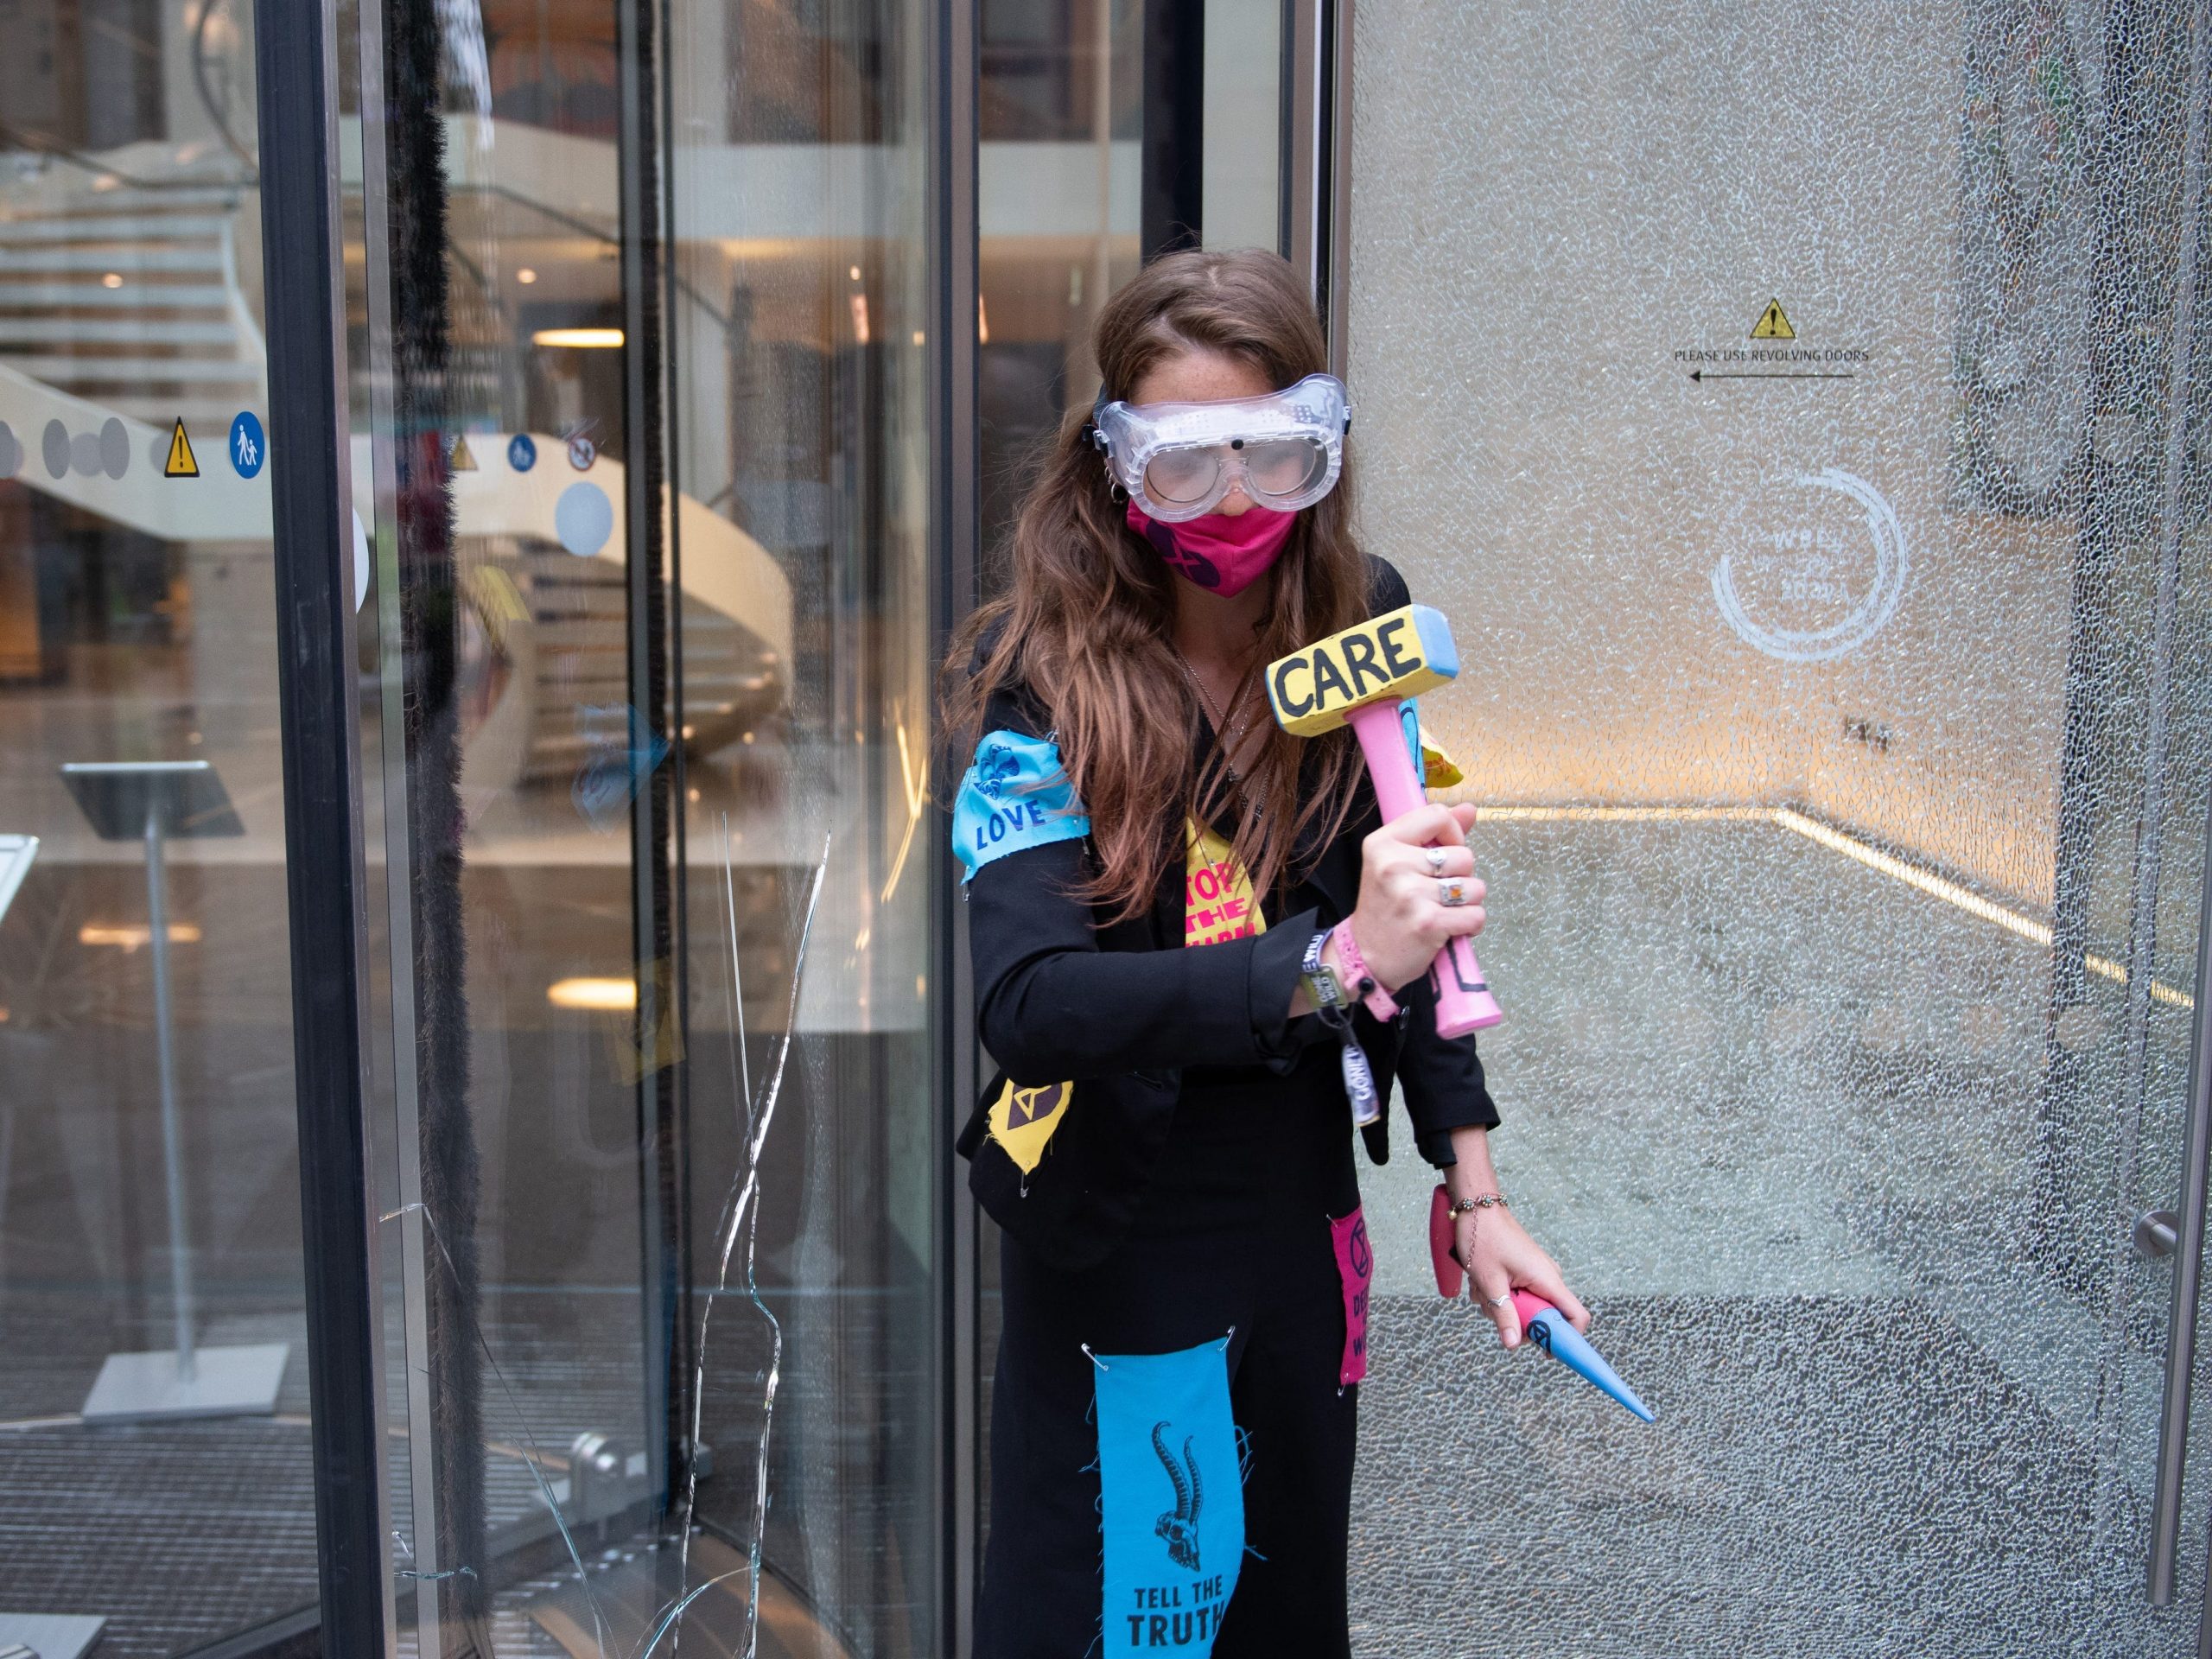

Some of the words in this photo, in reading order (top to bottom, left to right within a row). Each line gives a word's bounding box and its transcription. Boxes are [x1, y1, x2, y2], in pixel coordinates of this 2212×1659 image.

[1675, 349, 1719, 361] PLEASE
[1724, 349, 1747, 361] USE
[1751, 349, 1821, 361] REVOLVING
[1825, 349, 1870, 361] DOORS
[1274, 617, 1422, 718] CARE
[976, 799, 1046, 850] LOVE
[1186, 897, 1249, 933] THE
[1134, 1586, 1182, 1609] TELL
[1192, 1574, 1223, 1604] THE
[1127, 1600, 1225, 1646] TRUTH
